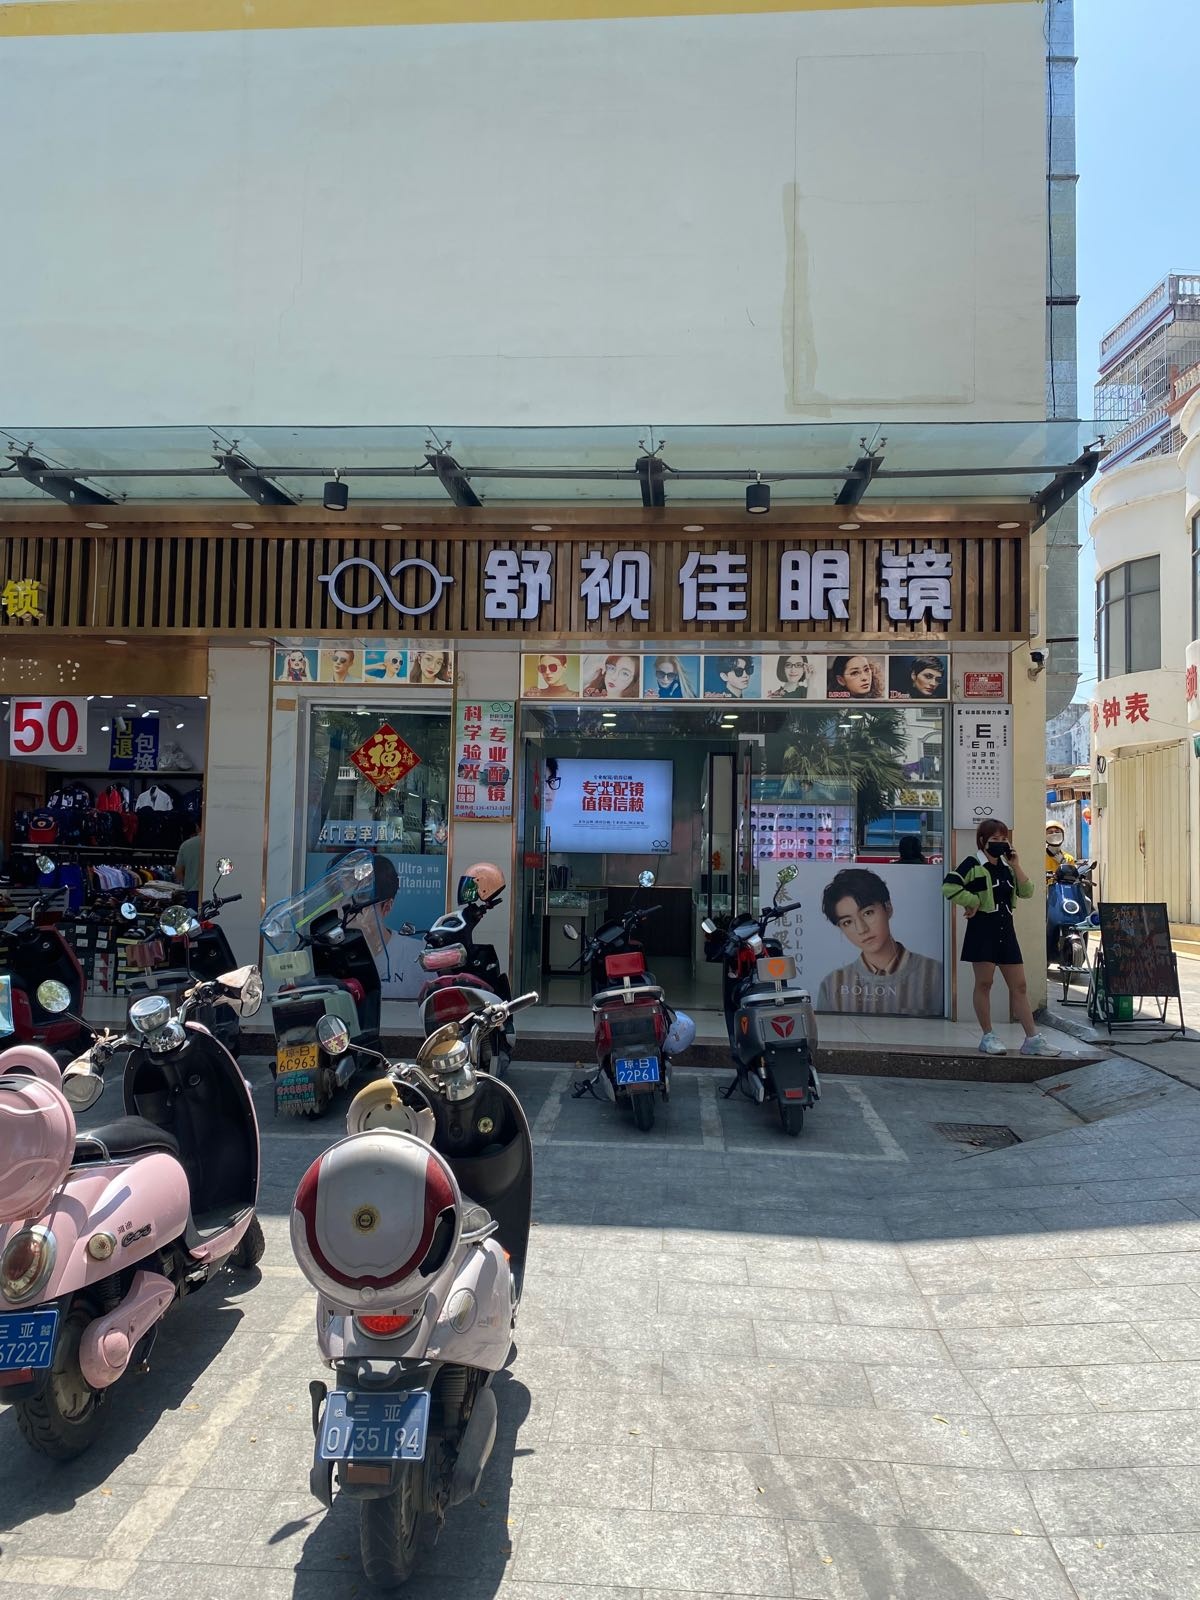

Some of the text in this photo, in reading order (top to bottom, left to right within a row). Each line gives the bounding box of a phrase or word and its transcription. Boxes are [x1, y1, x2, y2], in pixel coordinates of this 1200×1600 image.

[484, 549, 953, 622] 舒视佳眼镜
[2, 579, 44, 619] 锁
[134, 733, 155, 771] 包换
[368, 733, 402, 767] 福
[463, 705, 482, 781] 科学验光
[488, 727, 507, 801] 专业配镜
[582, 781, 645, 797] 专业配镜
[582, 796, 645, 812] 值得信赖
[398, 862, 423, 875] Ultra
[397, 876, 441, 889] Titanium
[795, 914, 803, 976] BOLON
[841, 984, 897, 997] BOLON
[279, 1056, 316, 1072] 6C963
[618, 1068, 655, 1083] 22P61
[351, 1404, 402, 1422] 三亚
[326, 1426, 420, 1453] 0135194
